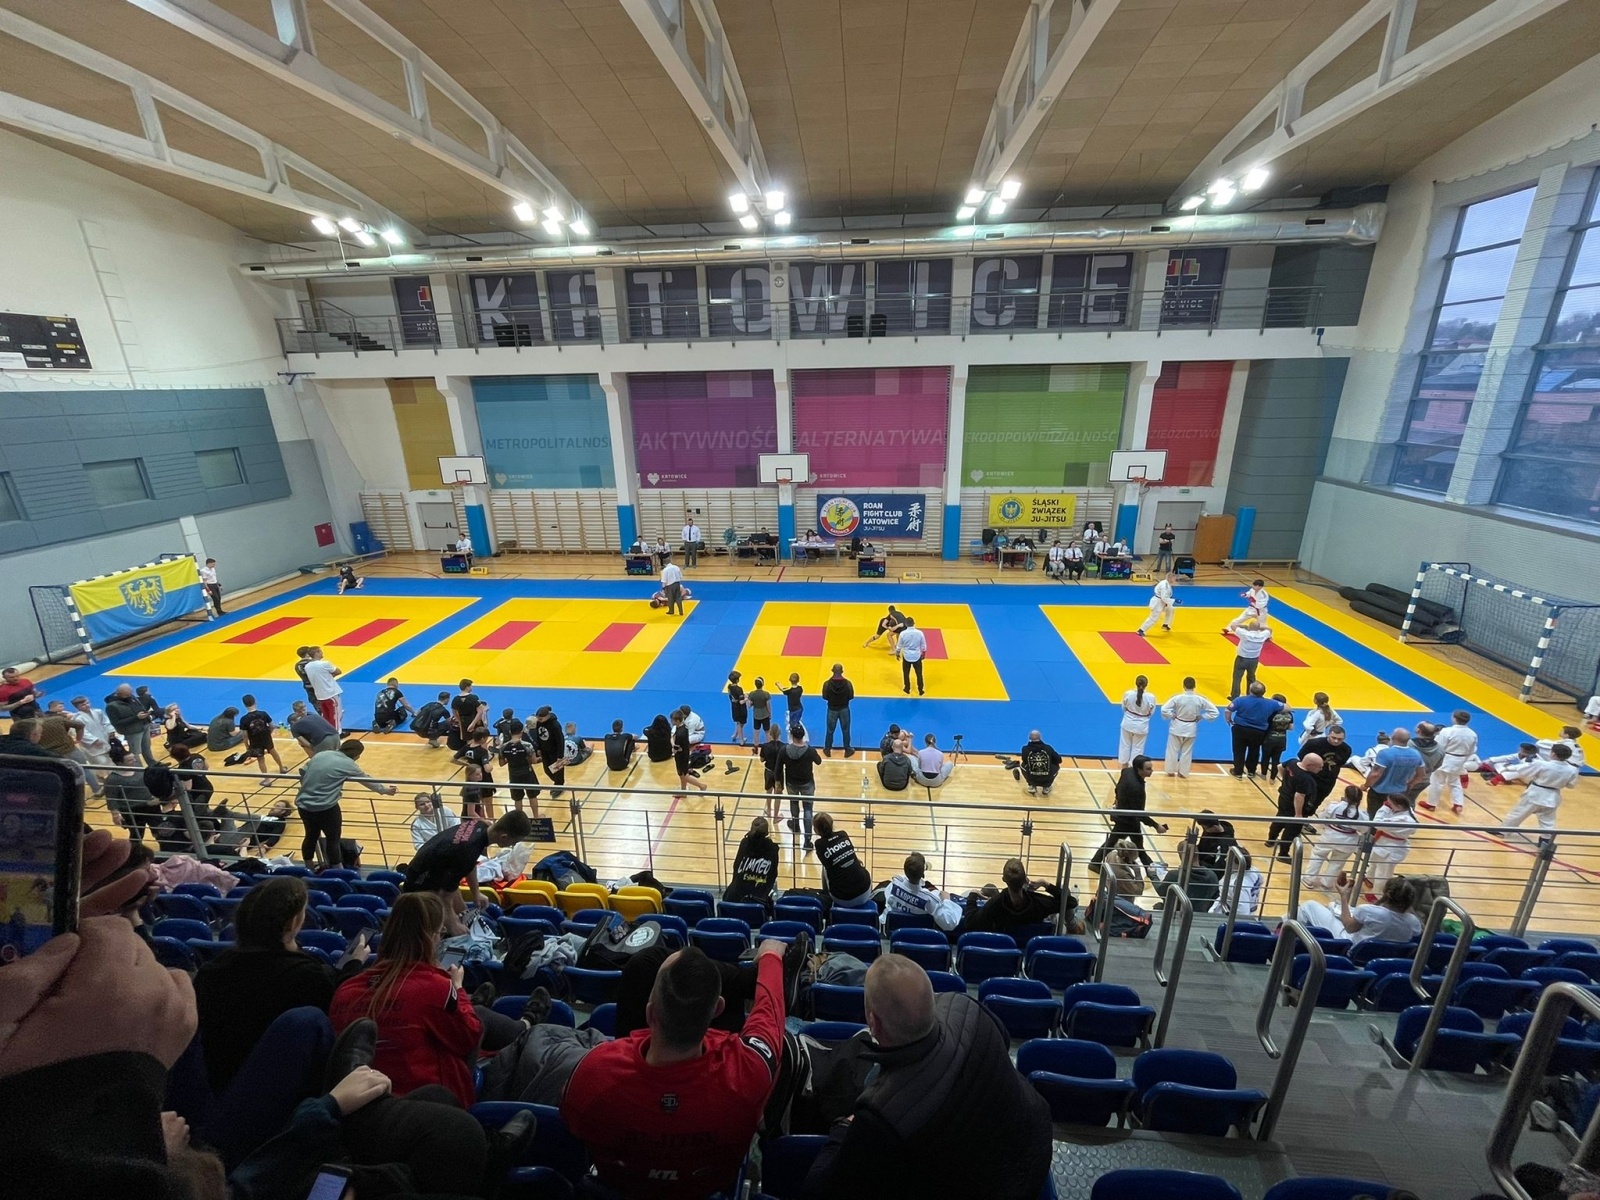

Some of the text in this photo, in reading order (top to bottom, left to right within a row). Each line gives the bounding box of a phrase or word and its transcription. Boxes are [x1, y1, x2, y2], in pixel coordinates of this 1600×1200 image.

[639, 425, 776, 450] AKTYWNOŚĆ
[797, 429, 943, 447] ALTERNATYWA
[1032, 497, 1059, 507] ŚLĄSKI
[1031, 507, 1067, 515] ZWIĄZEK
[1030, 515, 1067, 523] JU-JITSU
[824, 840, 851, 858] choice
[737, 857, 772, 875] LIMITED
[648, 1169, 679, 1180] KTL
